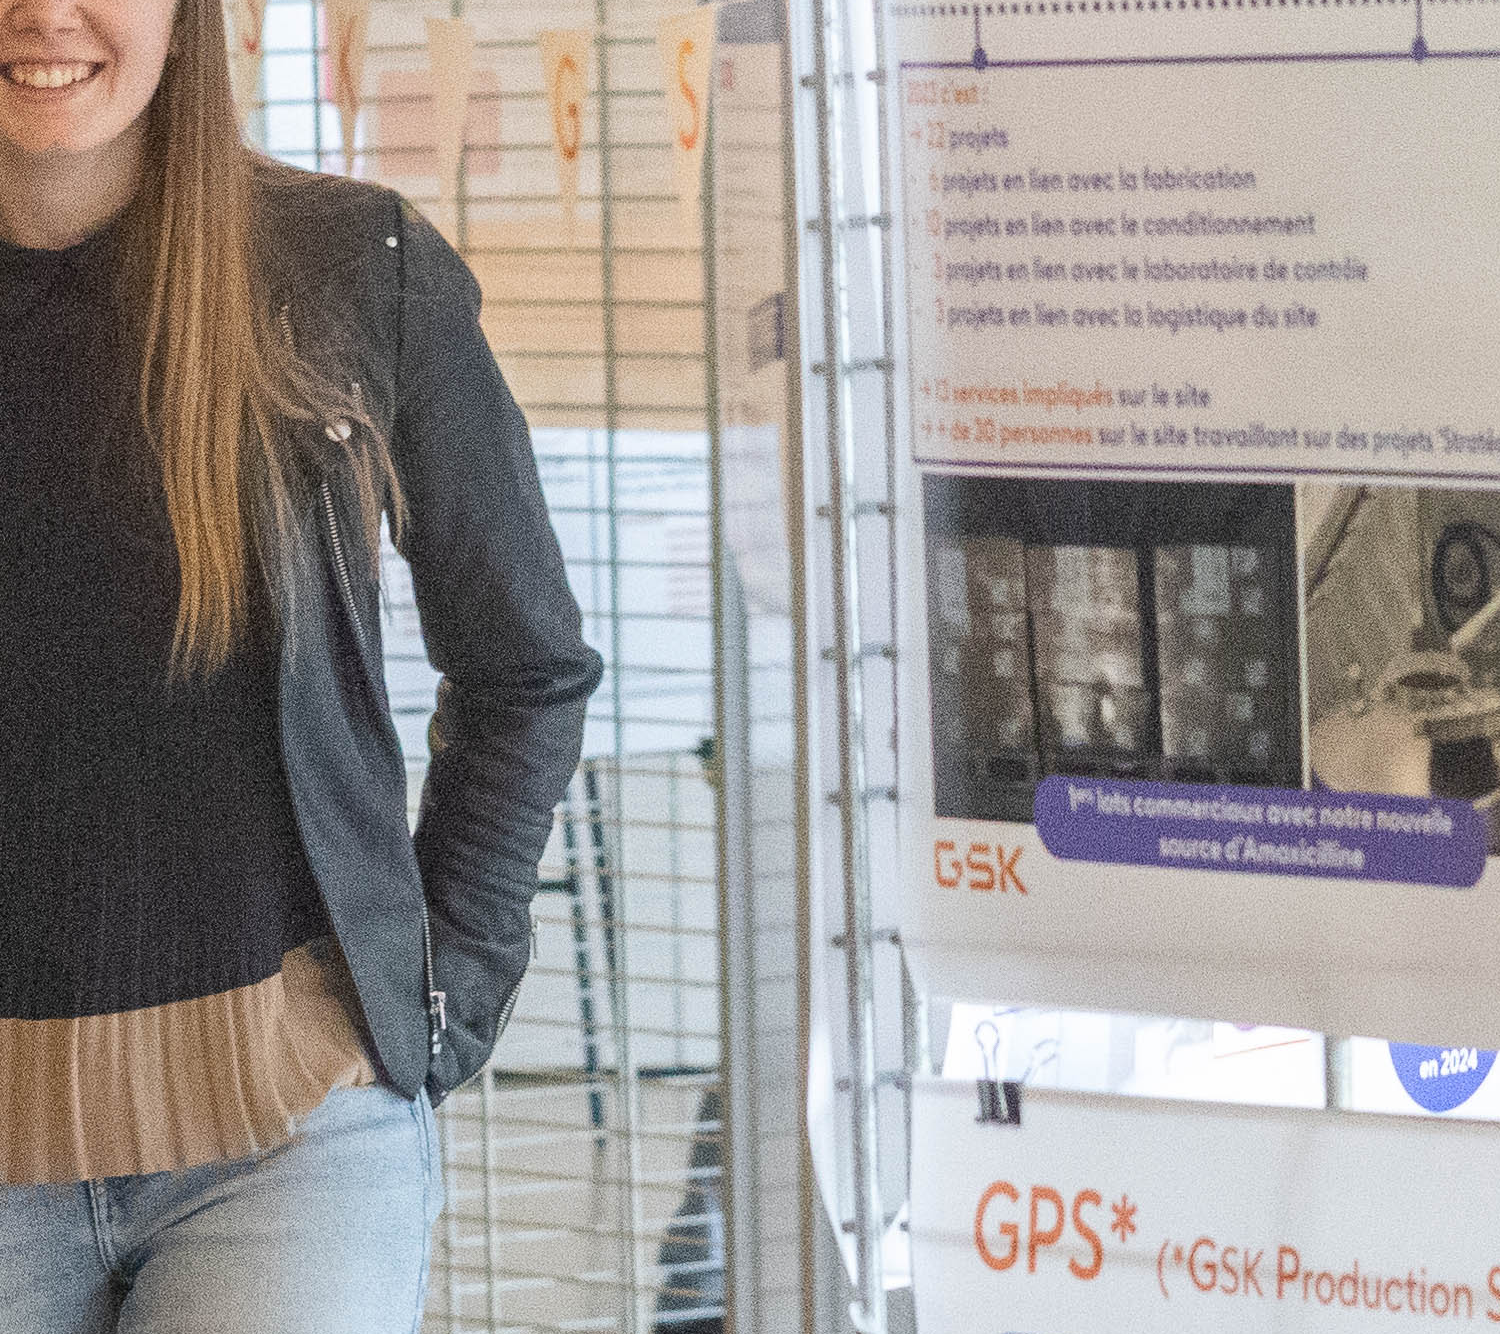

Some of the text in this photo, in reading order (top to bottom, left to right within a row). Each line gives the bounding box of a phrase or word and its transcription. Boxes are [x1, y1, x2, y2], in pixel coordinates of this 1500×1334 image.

[935, 840, 1028, 896] GSK
[1419, 1047, 1478, 1080] en 2024
[1274, 1247, 1475, 1318] Production
